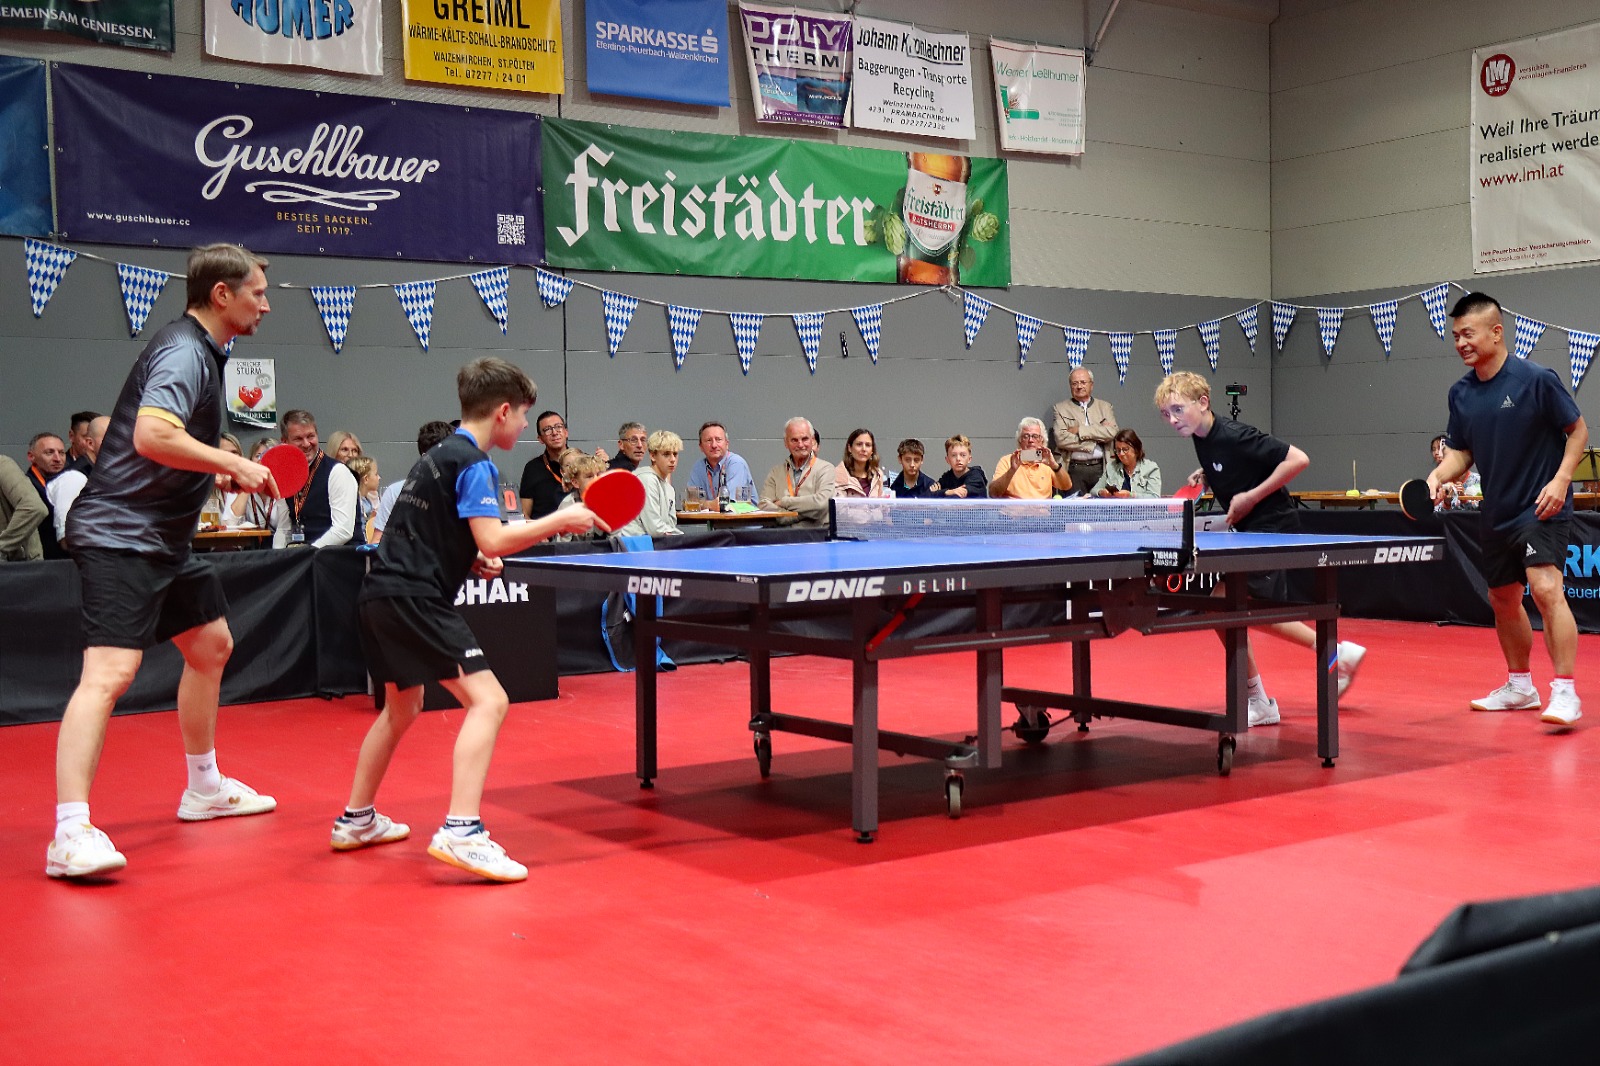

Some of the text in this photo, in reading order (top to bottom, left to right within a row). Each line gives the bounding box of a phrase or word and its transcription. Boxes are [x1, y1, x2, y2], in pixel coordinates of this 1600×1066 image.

[0, 7, 157, 39] EMEINSAM GENIESSEN.
[408, 23, 558, 54] WÄRME-KÄLTE-SCHALL-BRANDSCHUTZ
[595, 21, 700, 52] SPARKASSE
[856, 27, 899, 51] Johann
[596, 39, 719, 64] Eferding-Peuerbach-Waizenkirchen
[750, 46, 840, 68] THERM
[445, 66, 462, 79] Tel.
[465, 69, 493, 81] 07277
[502, 73, 513, 83] 24
[516, 74, 527, 84] 01
[858, 57, 915, 80] Baggerungen
[893, 82, 936, 103] Recycling
[1480, 120, 1515, 140] Weil
[1520, 118, 1550, 133] Ihre
[194, 114, 441, 201] Guschlbauer
[1479, 131, 1600, 165] realisiert werde
[86, 211, 191, 226] www.guschlbauer.cc
[276, 211, 373, 226] BESTES BACKEN.
[297, 224, 353, 236] SEIT 1919.
[236, 367, 262, 376] STURM
[1374, 545, 1434, 564] DONIC
[628, 576, 682, 597] DONIC
[786, 577, 967, 602] DONIC DELHI
[1563, 585, 1600, 599] euer
